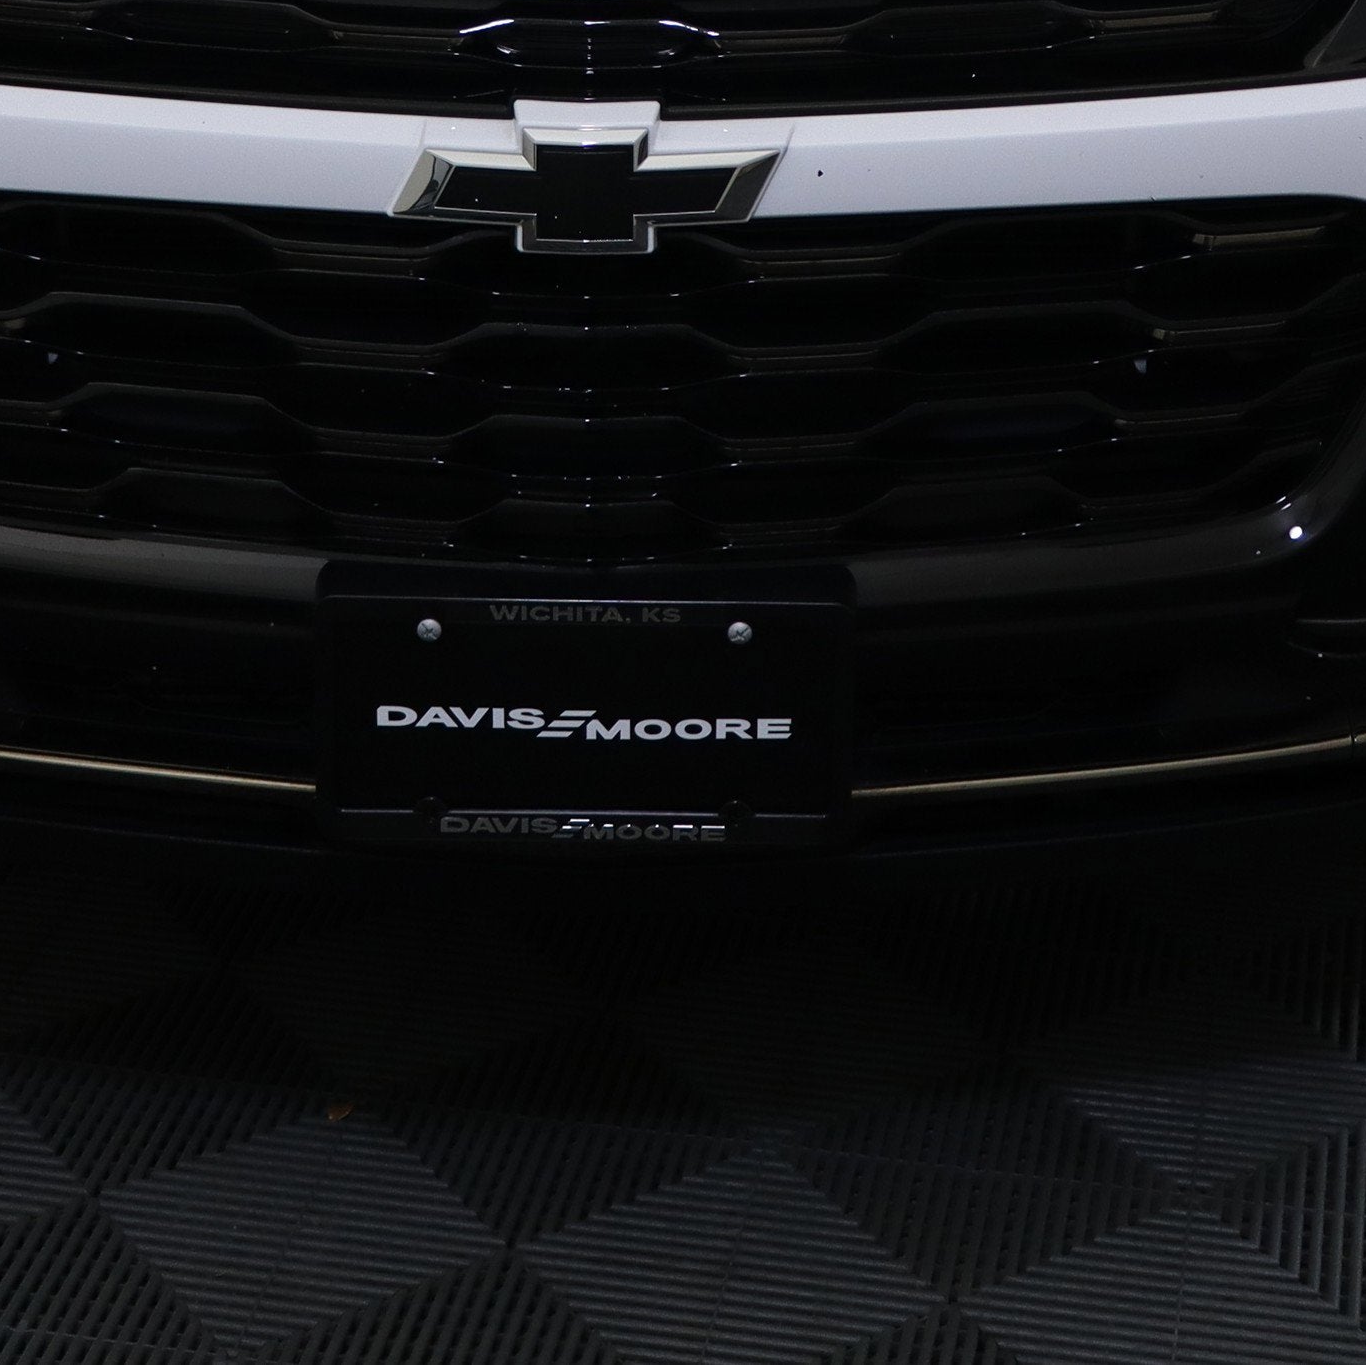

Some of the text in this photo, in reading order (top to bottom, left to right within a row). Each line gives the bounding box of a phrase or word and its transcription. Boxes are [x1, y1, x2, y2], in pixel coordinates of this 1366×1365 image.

[642, 606, 682, 624] KS
[376, 705, 792, 741] DAVIS MOORE
[440, 815, 726, 842] DAVIS MOORE
